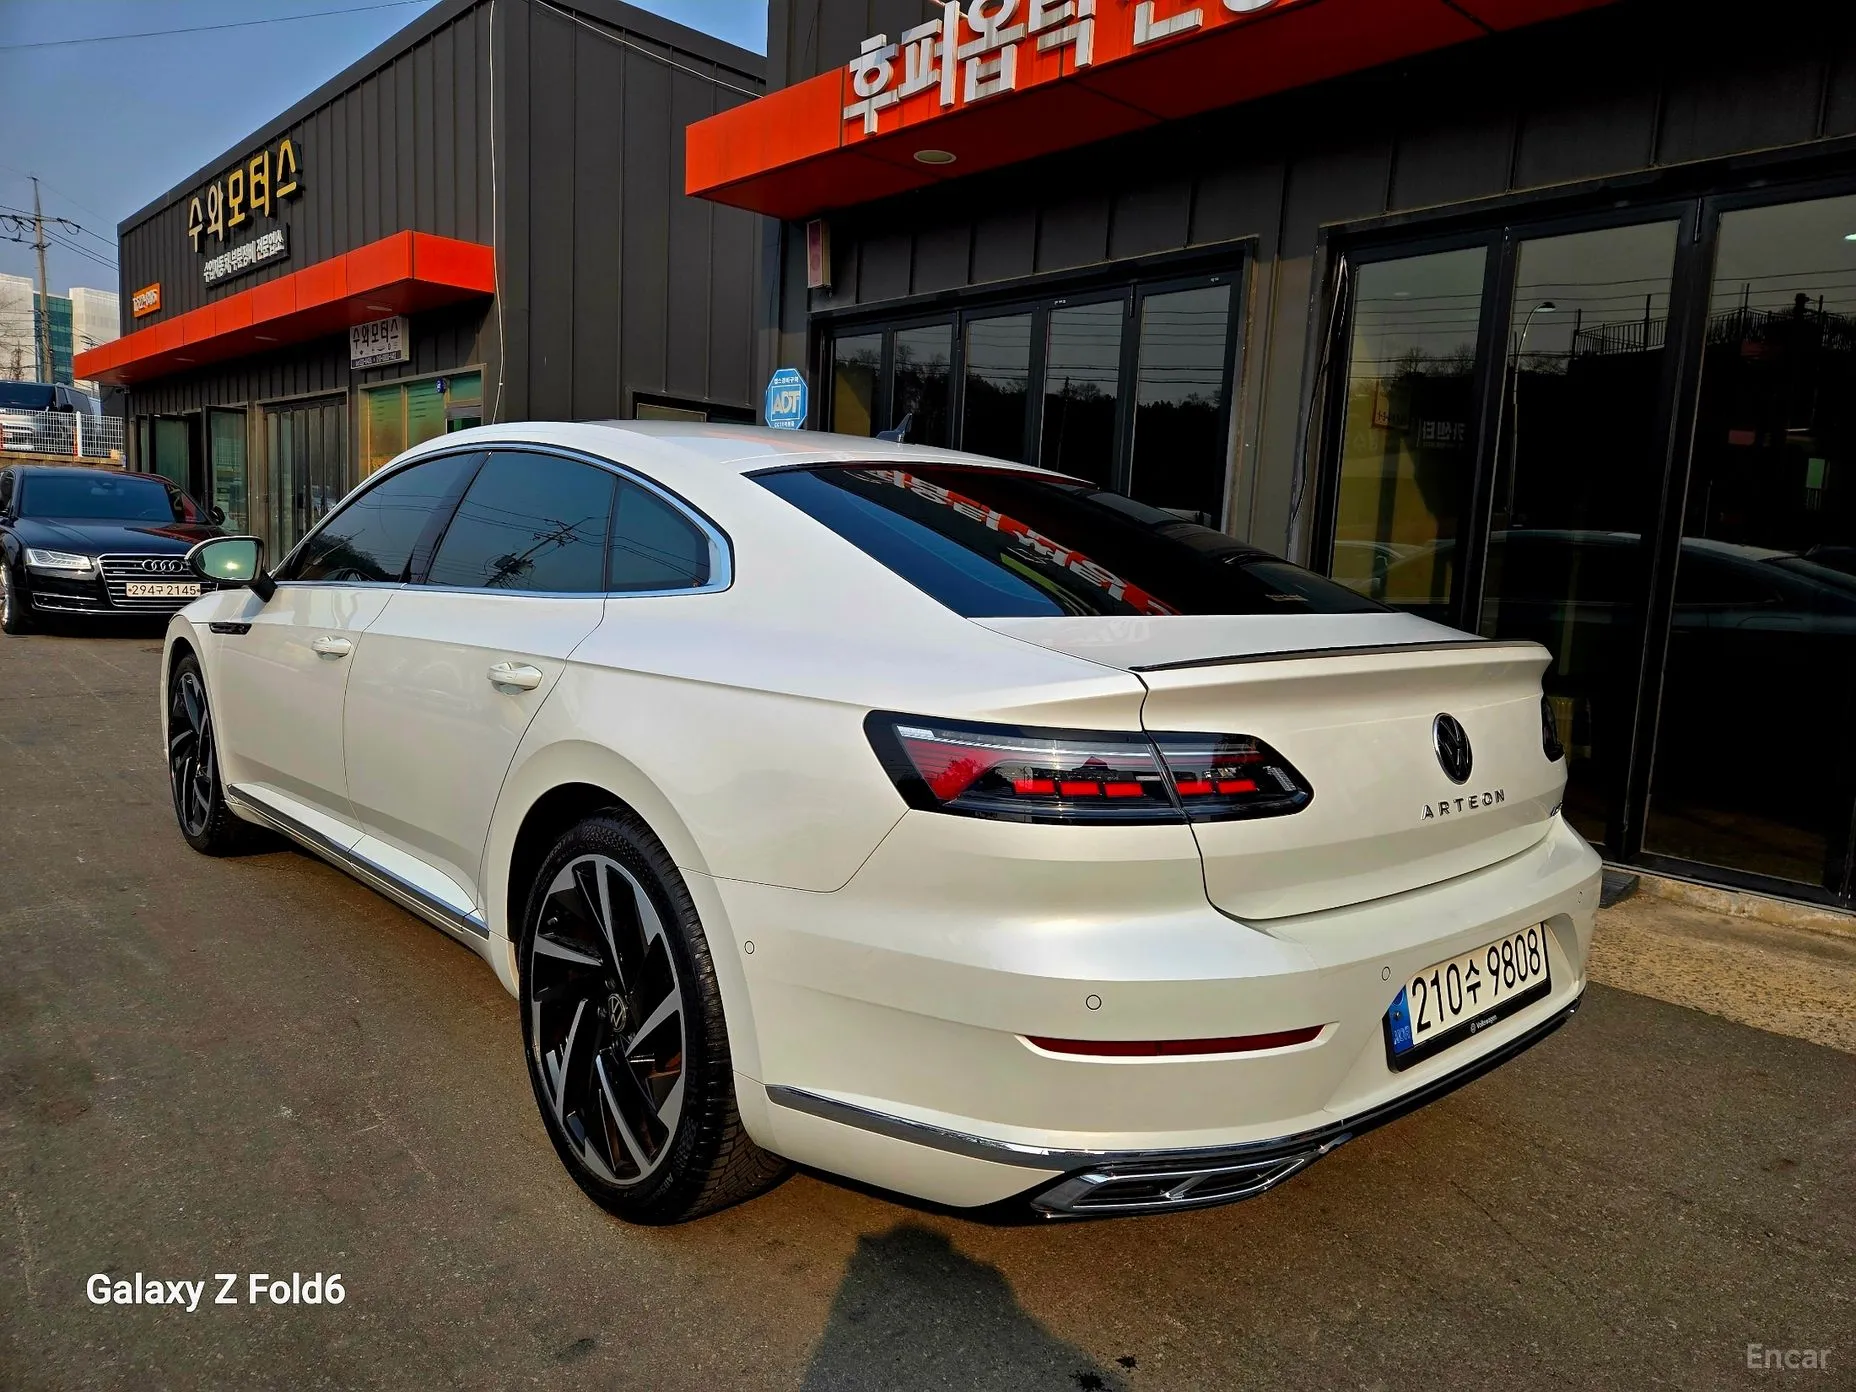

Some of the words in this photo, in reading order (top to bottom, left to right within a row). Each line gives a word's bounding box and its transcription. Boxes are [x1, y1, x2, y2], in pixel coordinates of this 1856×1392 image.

[188, 138, 297, 253] 수와모터스
[353, 318, 399, 350] 수와모터스
[772, 391, 800, 414] ADT
[131, 584, 164, 596] 294구
[166, 584, 196, 596] 2145
[1421, 789, 1506, 821] ARTEON
[1411, 958, 1482, 1034] 210수
[1486, 928, 1541, 997] 9808
